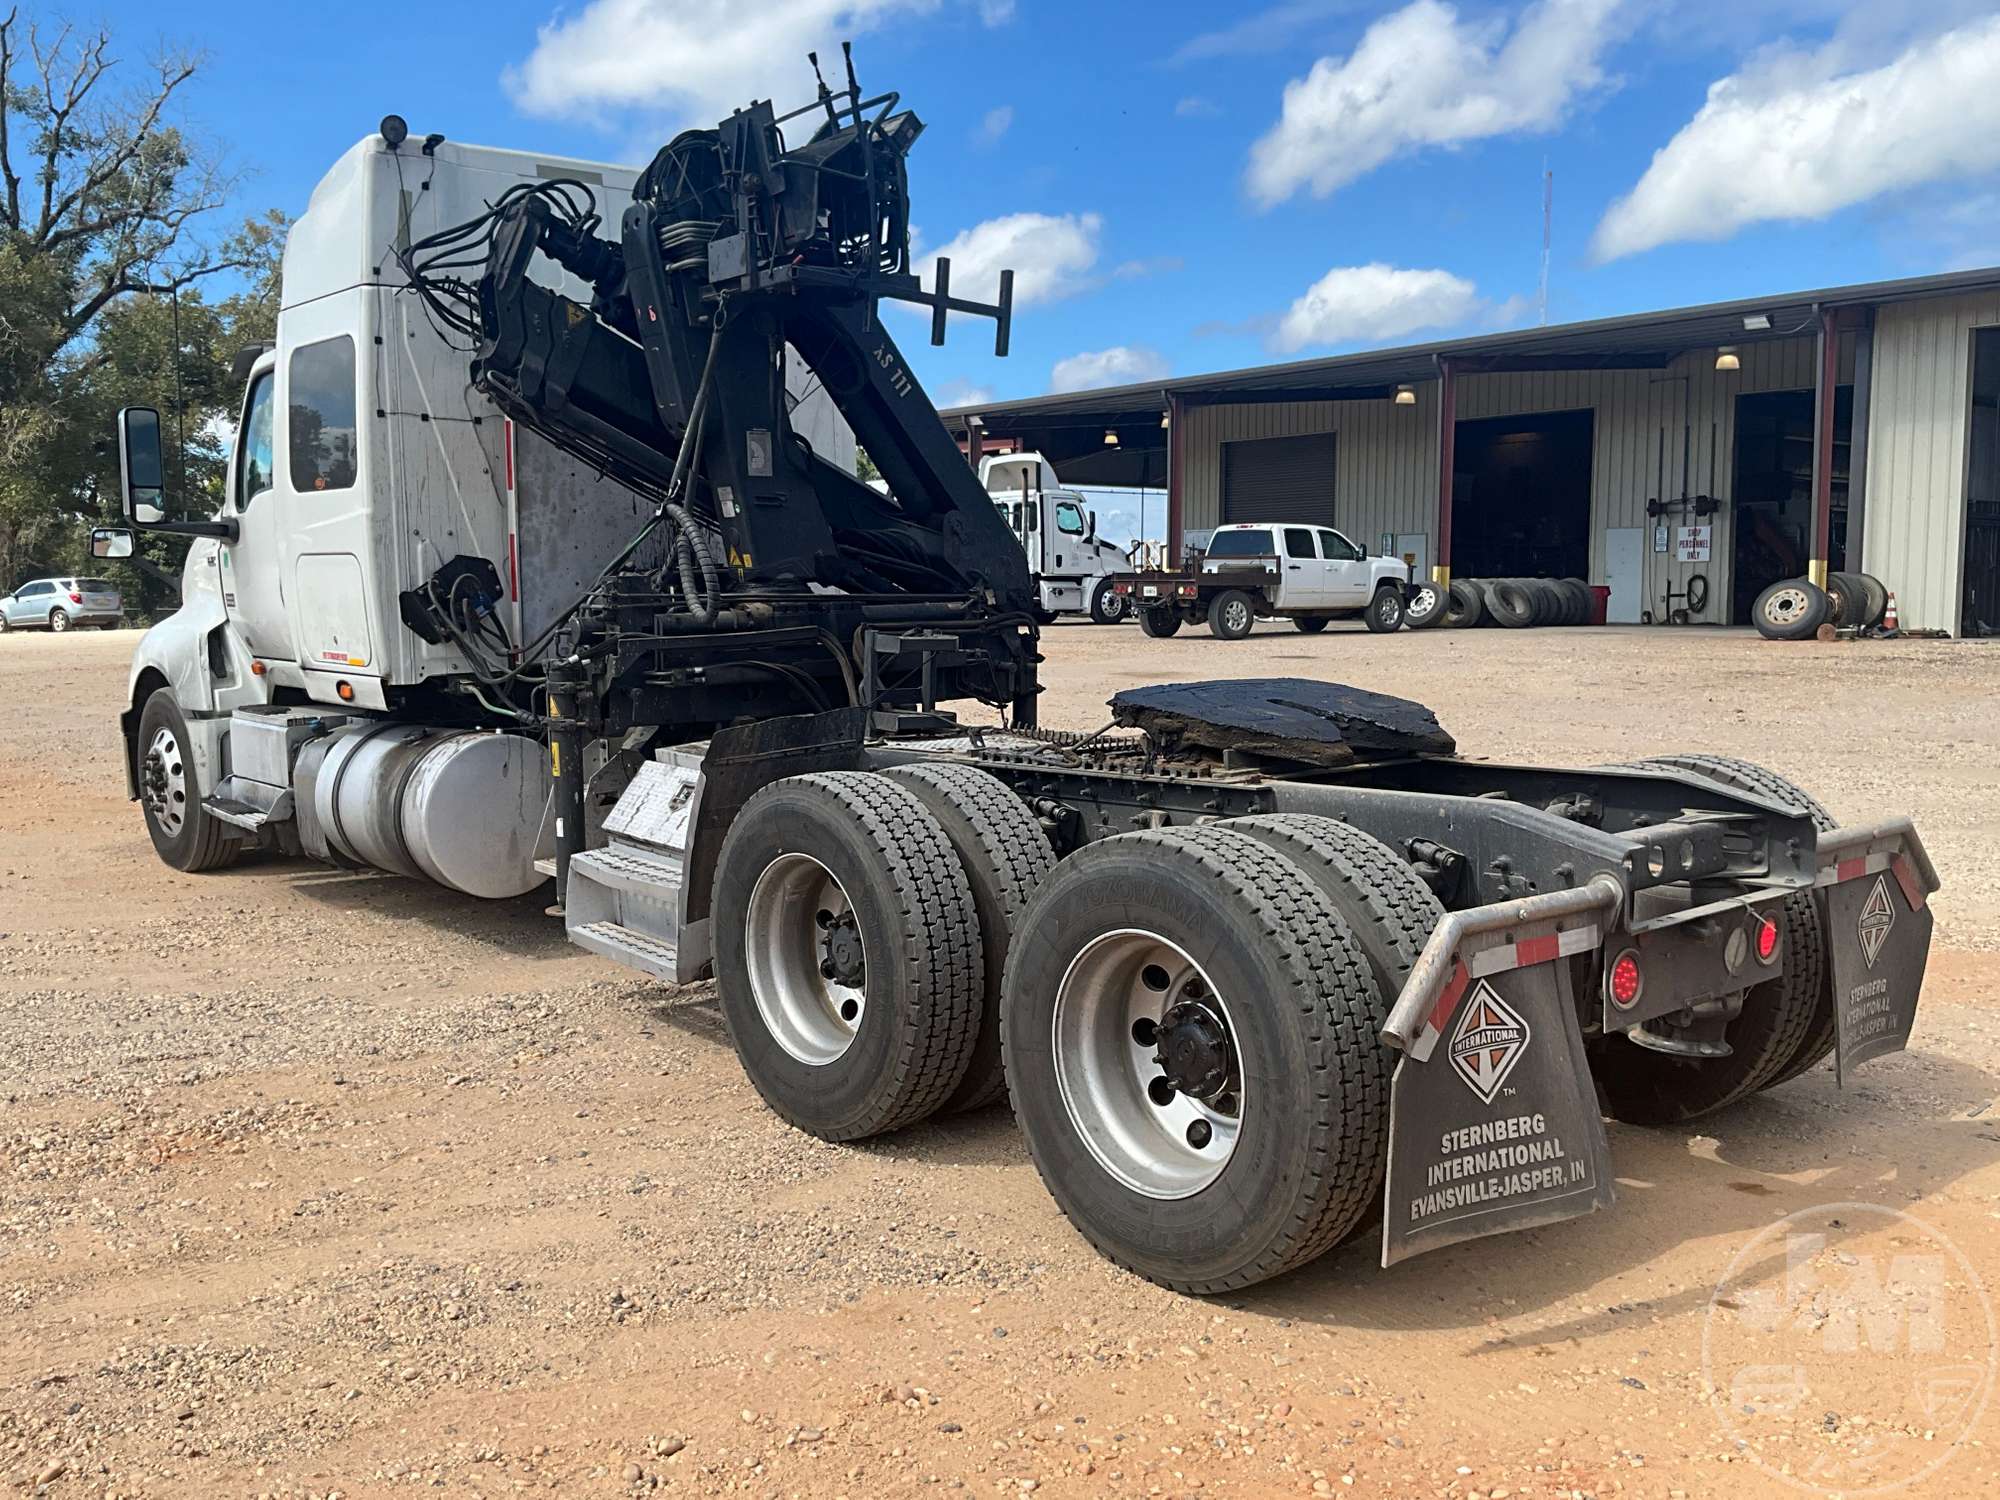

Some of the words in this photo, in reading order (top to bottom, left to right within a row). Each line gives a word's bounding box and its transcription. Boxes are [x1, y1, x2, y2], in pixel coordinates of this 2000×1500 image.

[890, 368, 912, 398] 111
[1679, 539, 1708, 549] PERSNNEL
[1455, 1029, 1519, 1052] INTERNATIONAL
[1503, 1087, 1516, 1096] TM
[1441, 1113, 1545, 1154] STERNBERG
[1427, 1138, 1565, 1187] INTERNATIONAL
[1410, 1165, 1568, 1221] EVANSVILLE-JASPER,
[1570, 1159, 1586, 1182] IN
